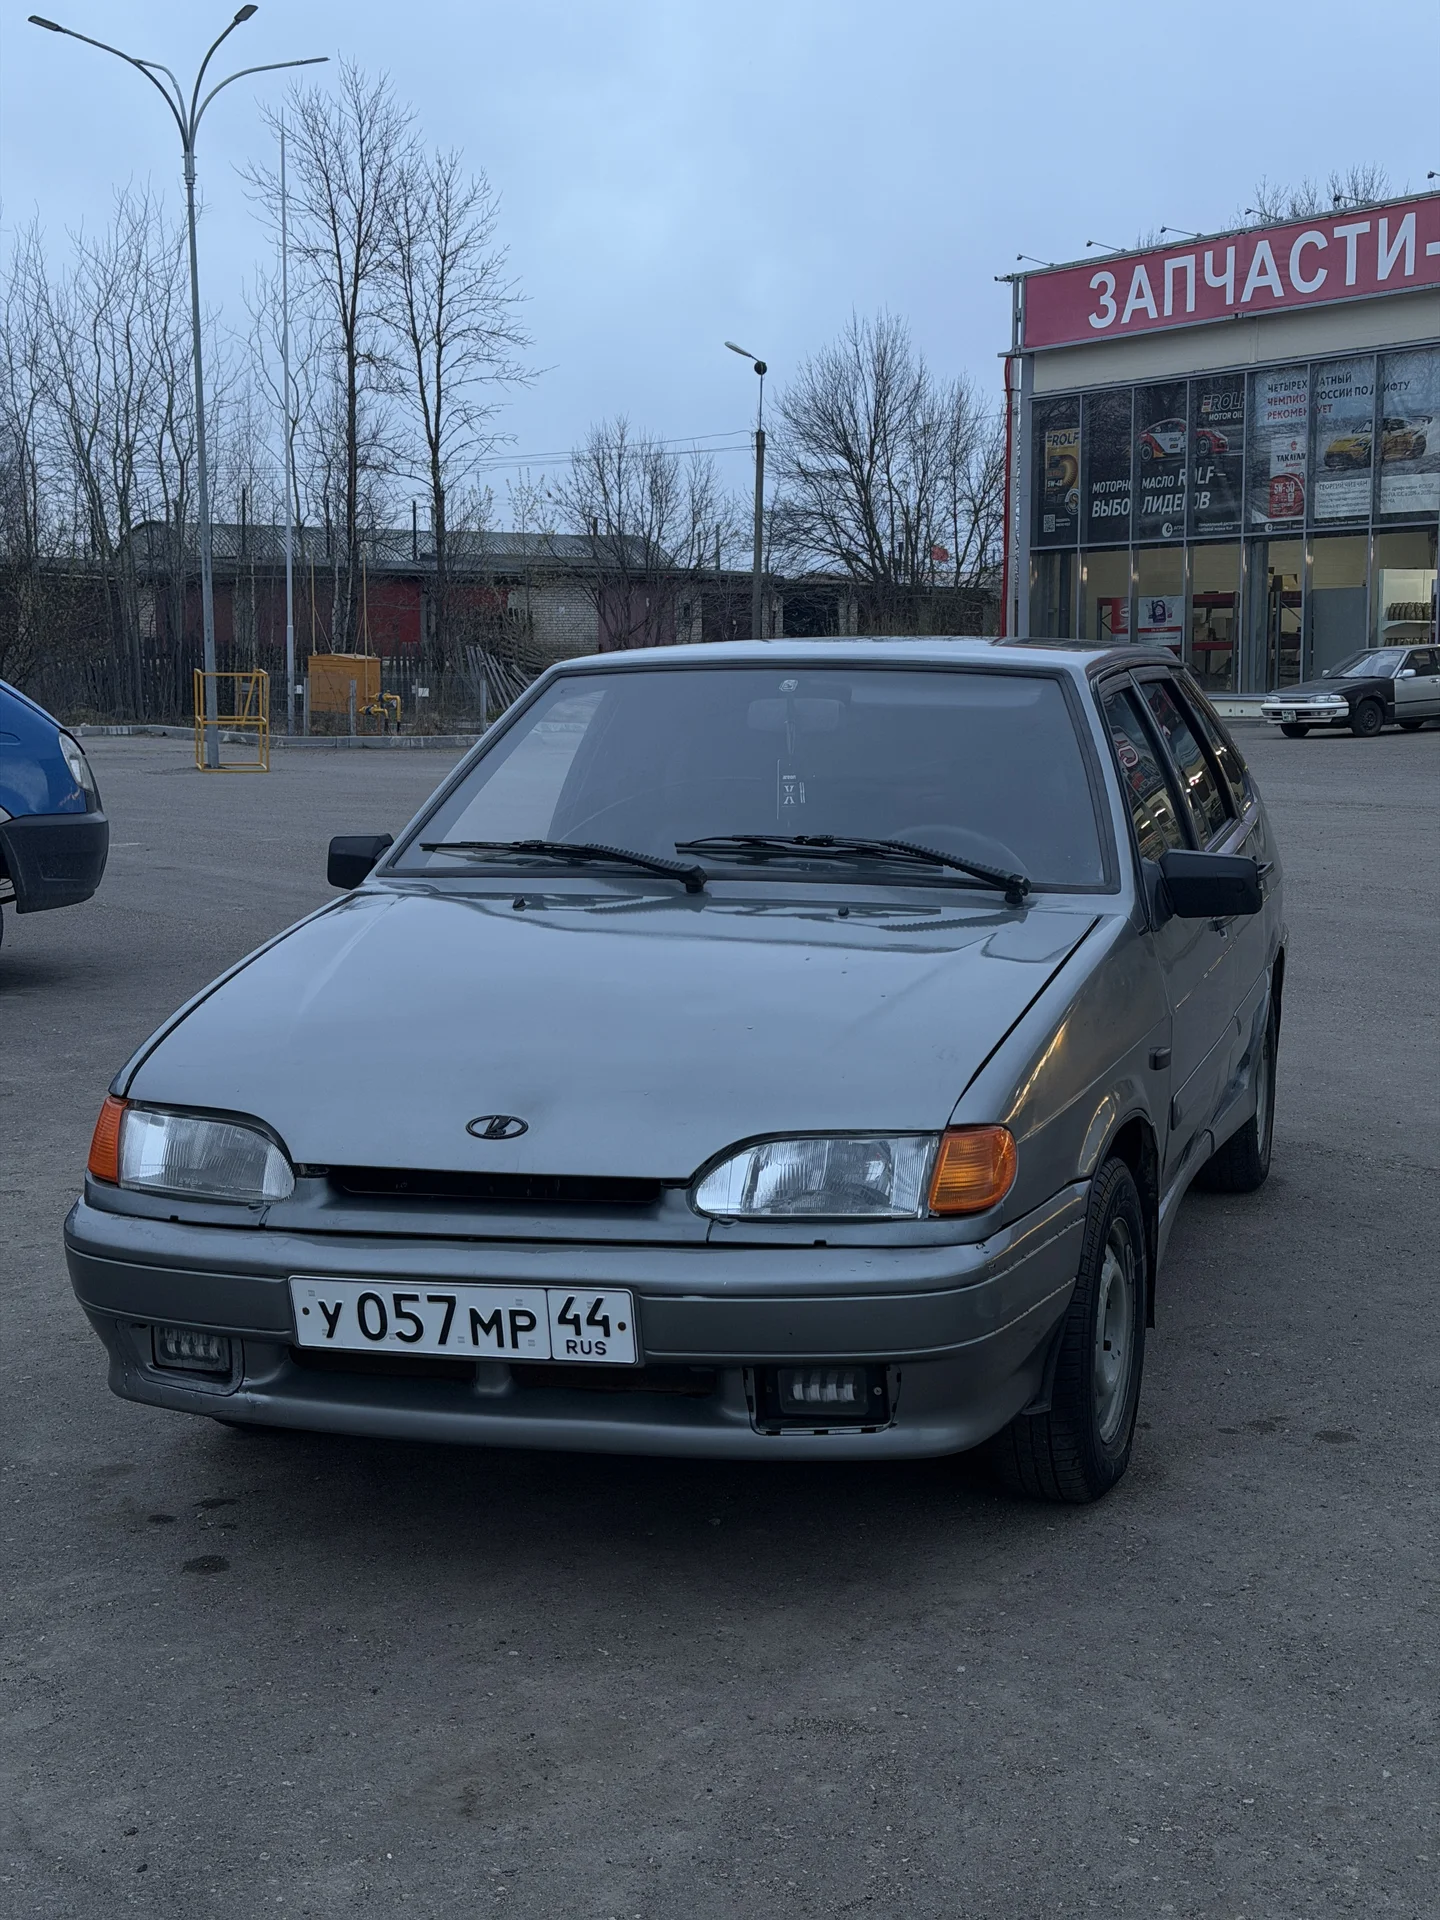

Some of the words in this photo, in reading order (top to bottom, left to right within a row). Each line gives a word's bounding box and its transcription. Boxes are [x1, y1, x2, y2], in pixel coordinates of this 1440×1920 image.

[1267, 393, 1307, 406] ЧЕМПИО
[1355, 385, 1369, 397] ПО
[1209, 412, 1232, 421] MOTOR
[1232, 410, 1244, 419] OIL
[1051, 431, 1080, 447] ROLF
[1091, 479, 1131, 494] МОТОРН
[1141, 475, 1175, 490] МАСЛО
[1178, 465, 1215, 487] RLF
[1273, 481, 1296, 494] 5W-30
[1091, 497, 1131, 518] ВЫБО
[557, 1295, 611, 1338] 44
[566, 1339, 607, 1356] RUS
